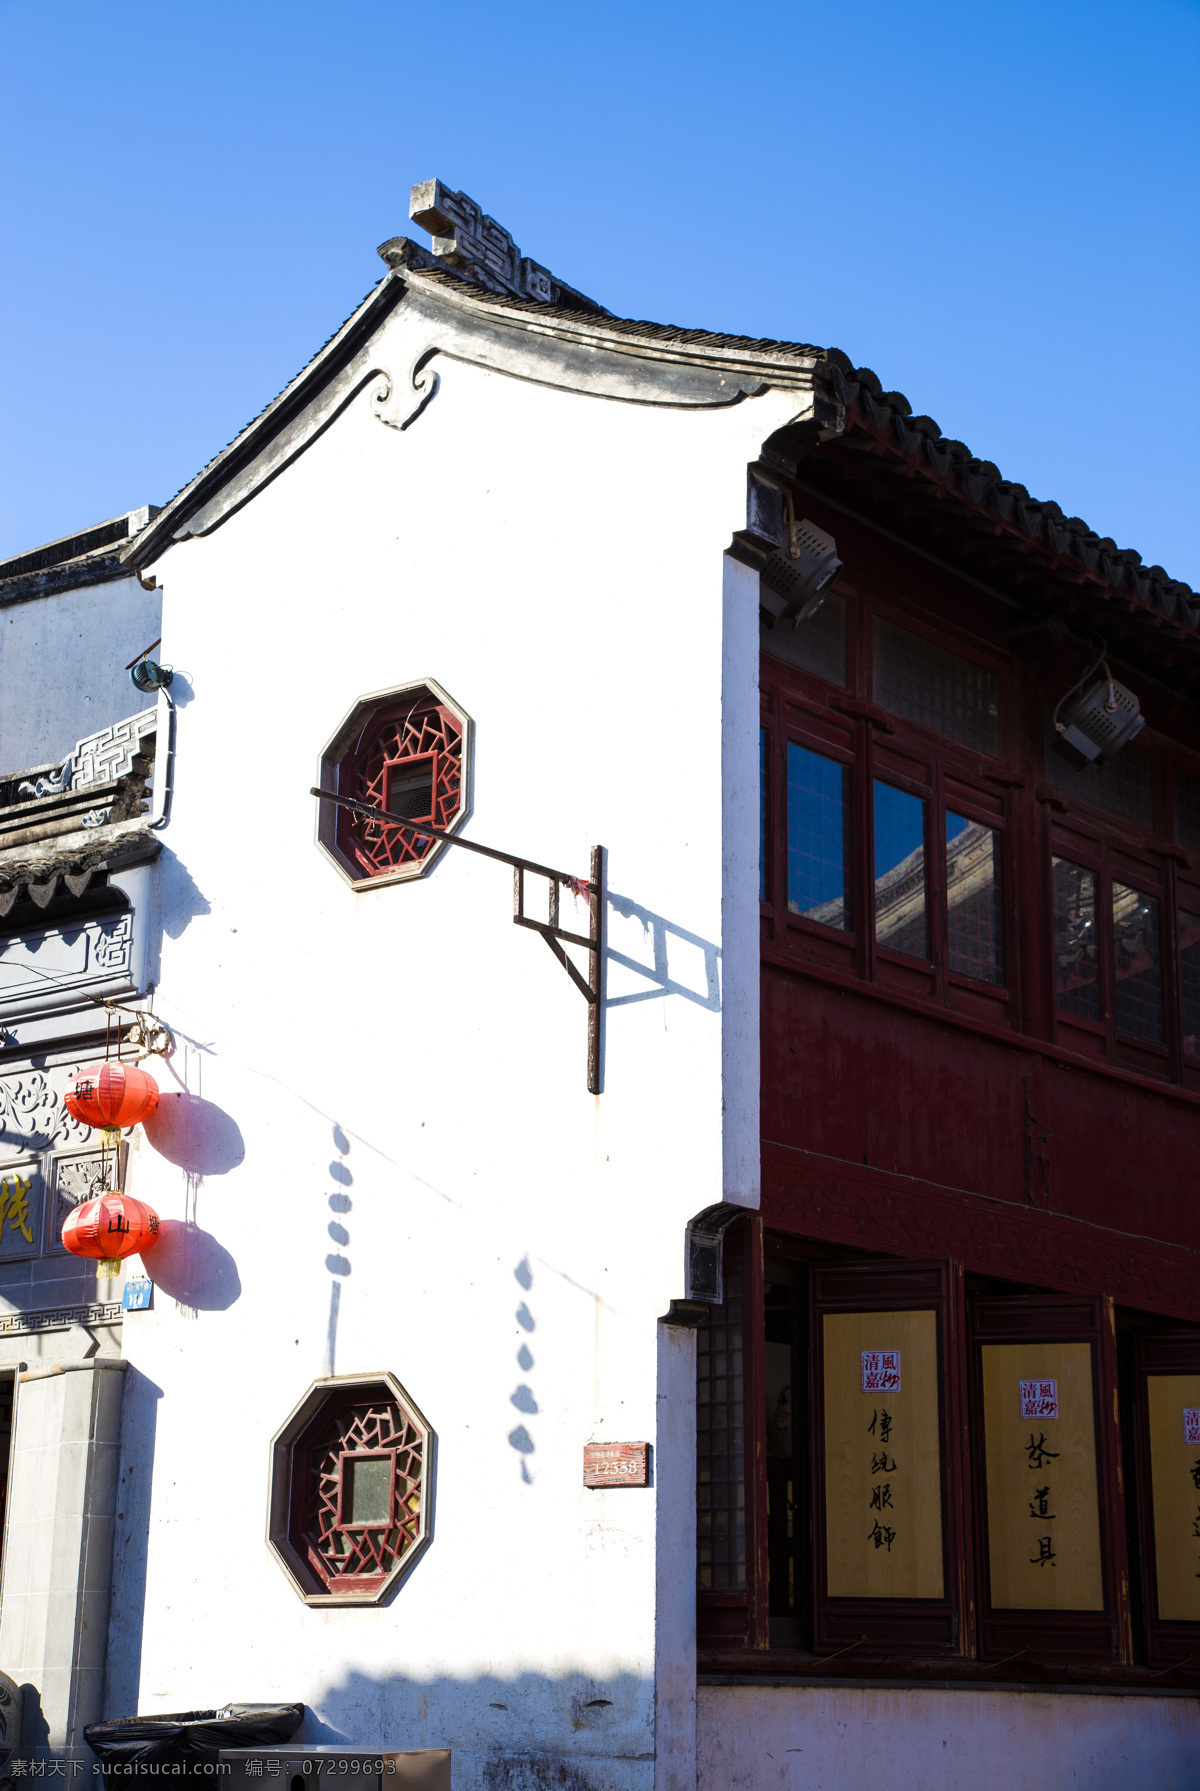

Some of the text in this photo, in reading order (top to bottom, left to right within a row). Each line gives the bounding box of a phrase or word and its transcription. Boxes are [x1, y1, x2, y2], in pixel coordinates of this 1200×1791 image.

[73, 1080, 95, 1101] 塘
[108, 1214, 130, 1235] 山
[1025, 1432, 1060, 1568] 茶道具
